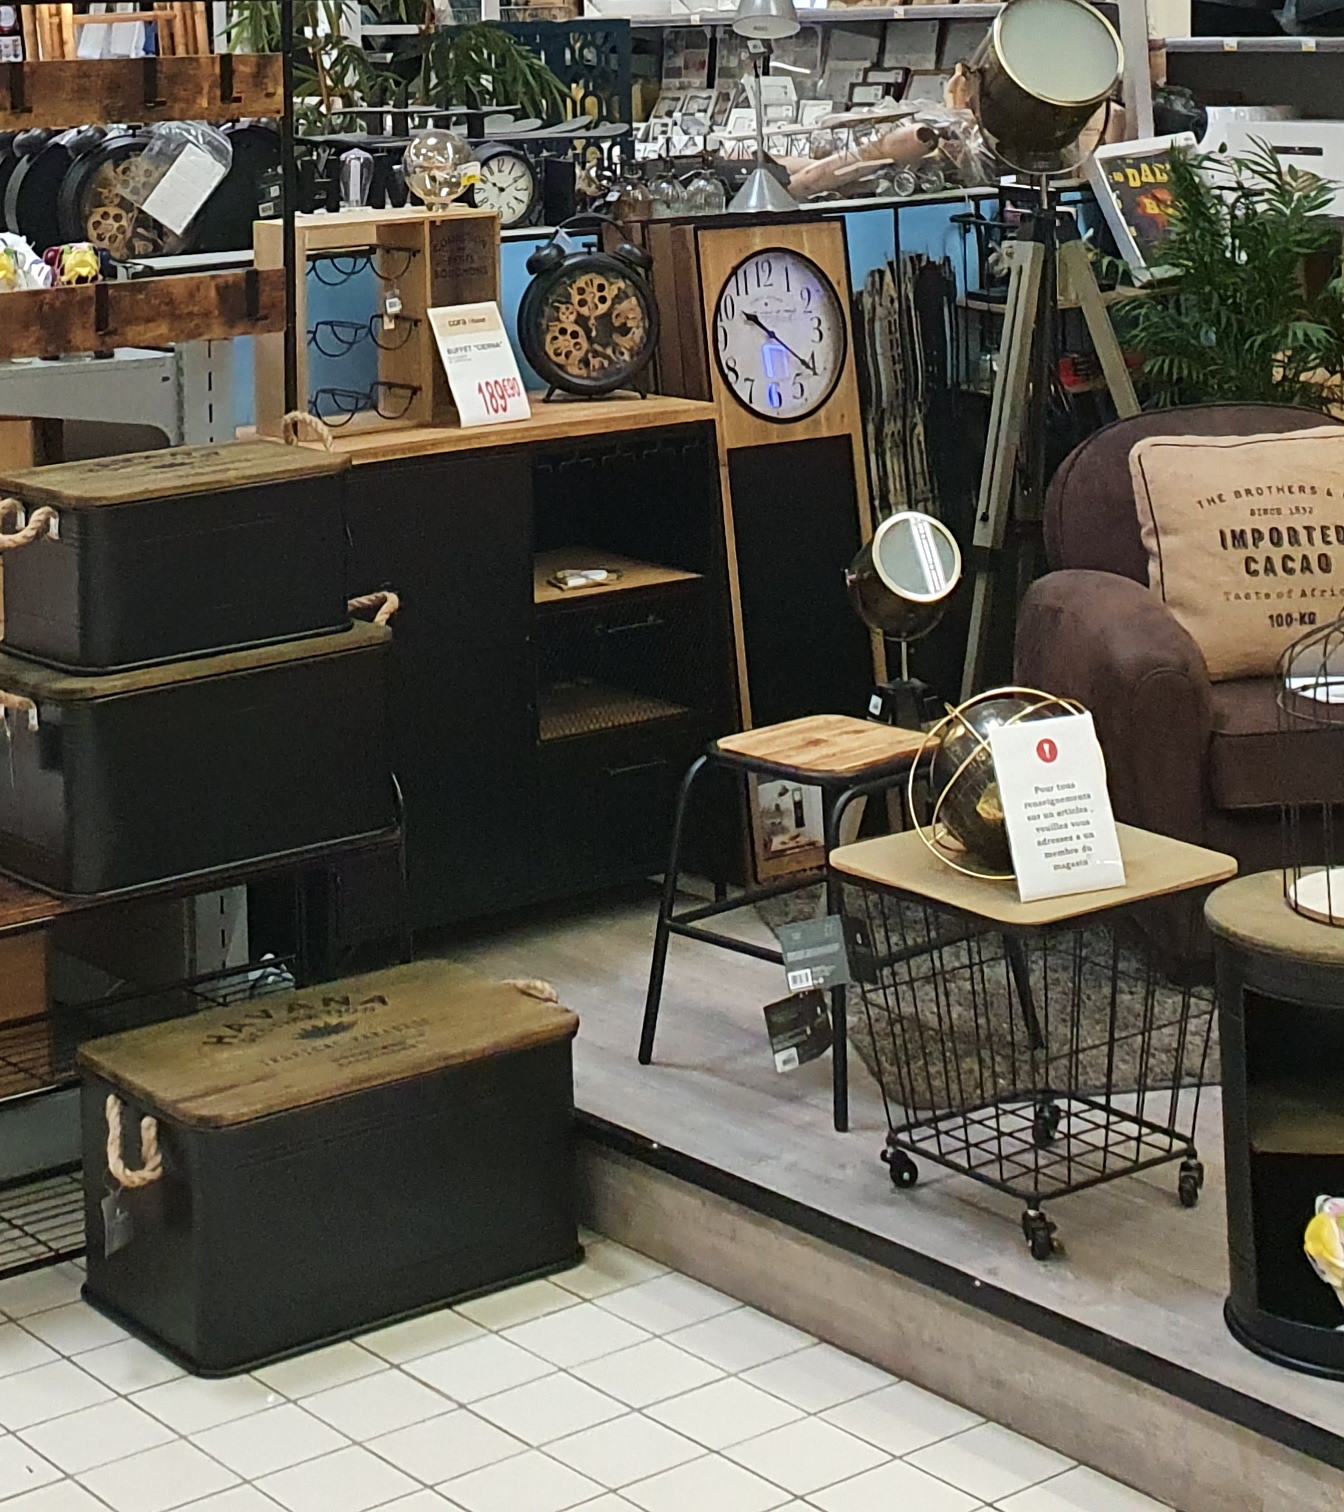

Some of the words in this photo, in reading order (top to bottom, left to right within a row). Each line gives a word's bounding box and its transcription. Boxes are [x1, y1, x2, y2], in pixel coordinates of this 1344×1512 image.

[755, 259, 773, 288] 12
[810, 316, 824, 344] 3
[1196, 493, 1226, 509] THE
[1234, 484, 1318, 500] BROTHERS
[1244, 553, 1332, 577] CACAO
[1223, 591, 1271, 601] Taste
[1276, 589, 1294, 599] of
[1034, 785, 1054, 795] Pour
[1056, 782, 1076, 791] tous
[202, 994, 389, 1046] HAVANA
